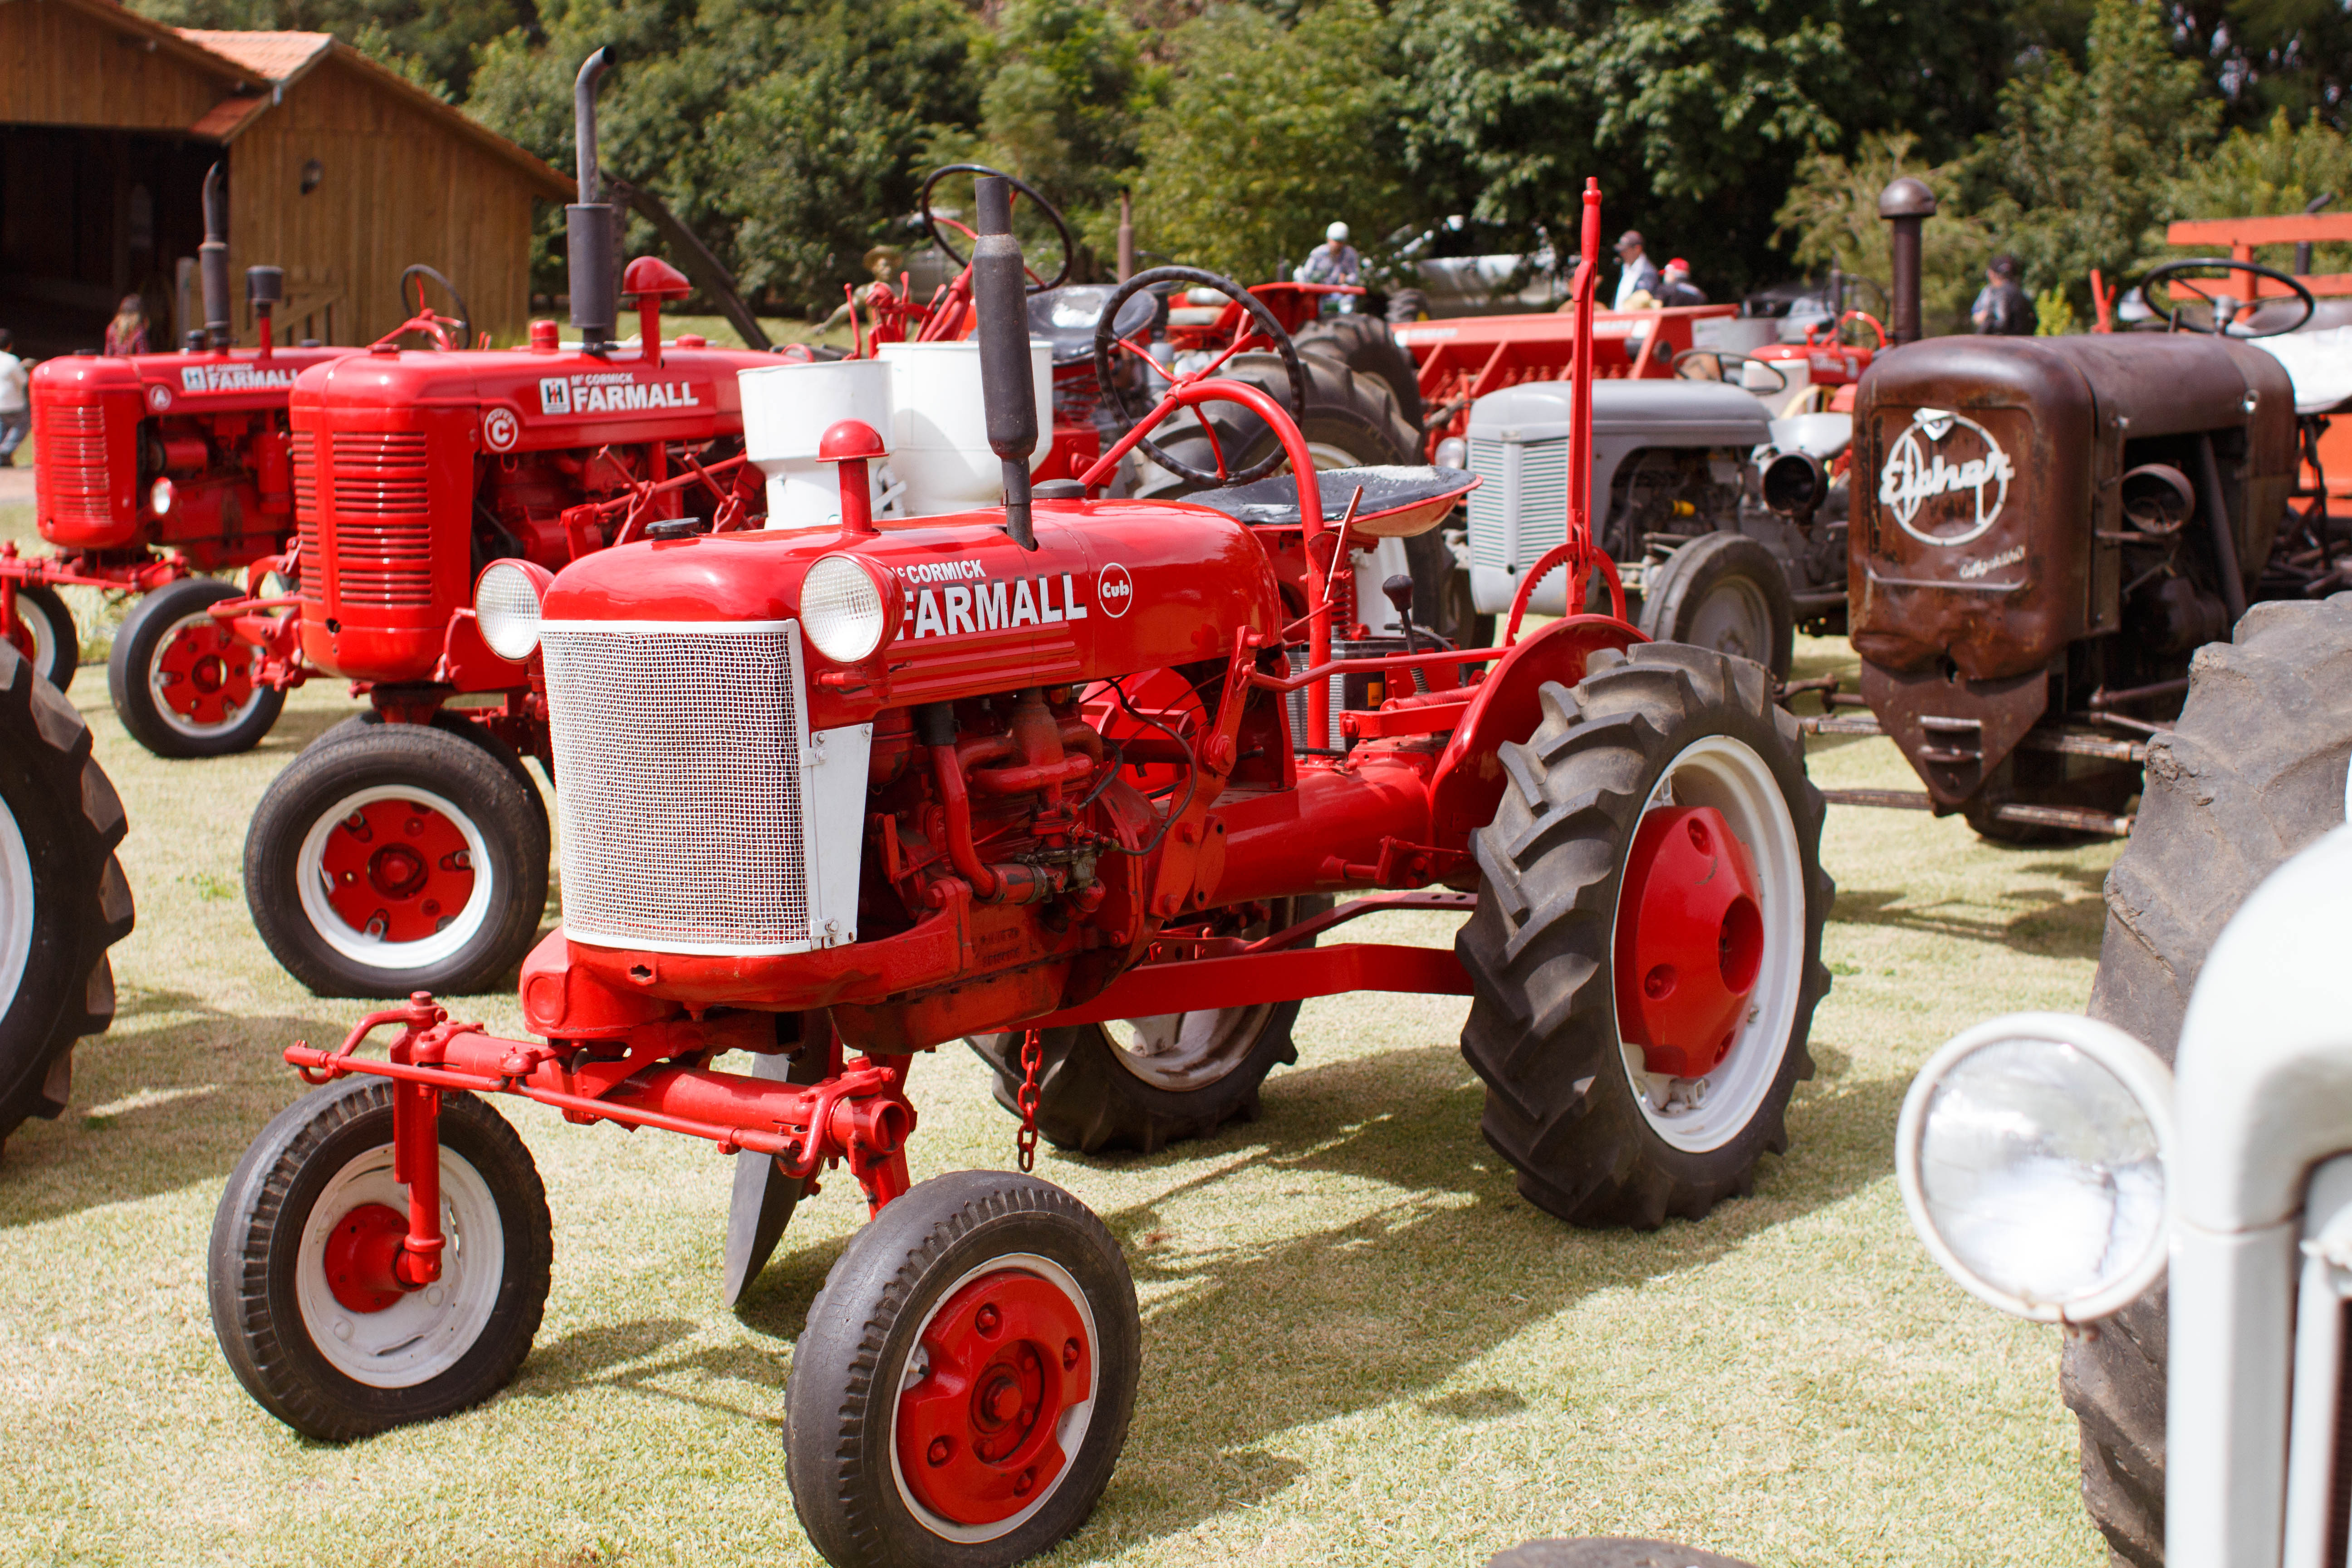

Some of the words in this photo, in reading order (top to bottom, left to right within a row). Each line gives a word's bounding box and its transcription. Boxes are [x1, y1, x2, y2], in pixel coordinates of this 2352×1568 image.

[572, 382, 699, 412] FARMALL
[492, 419, 510, 444] C
[1102, 579, 1130, 598] Cub
